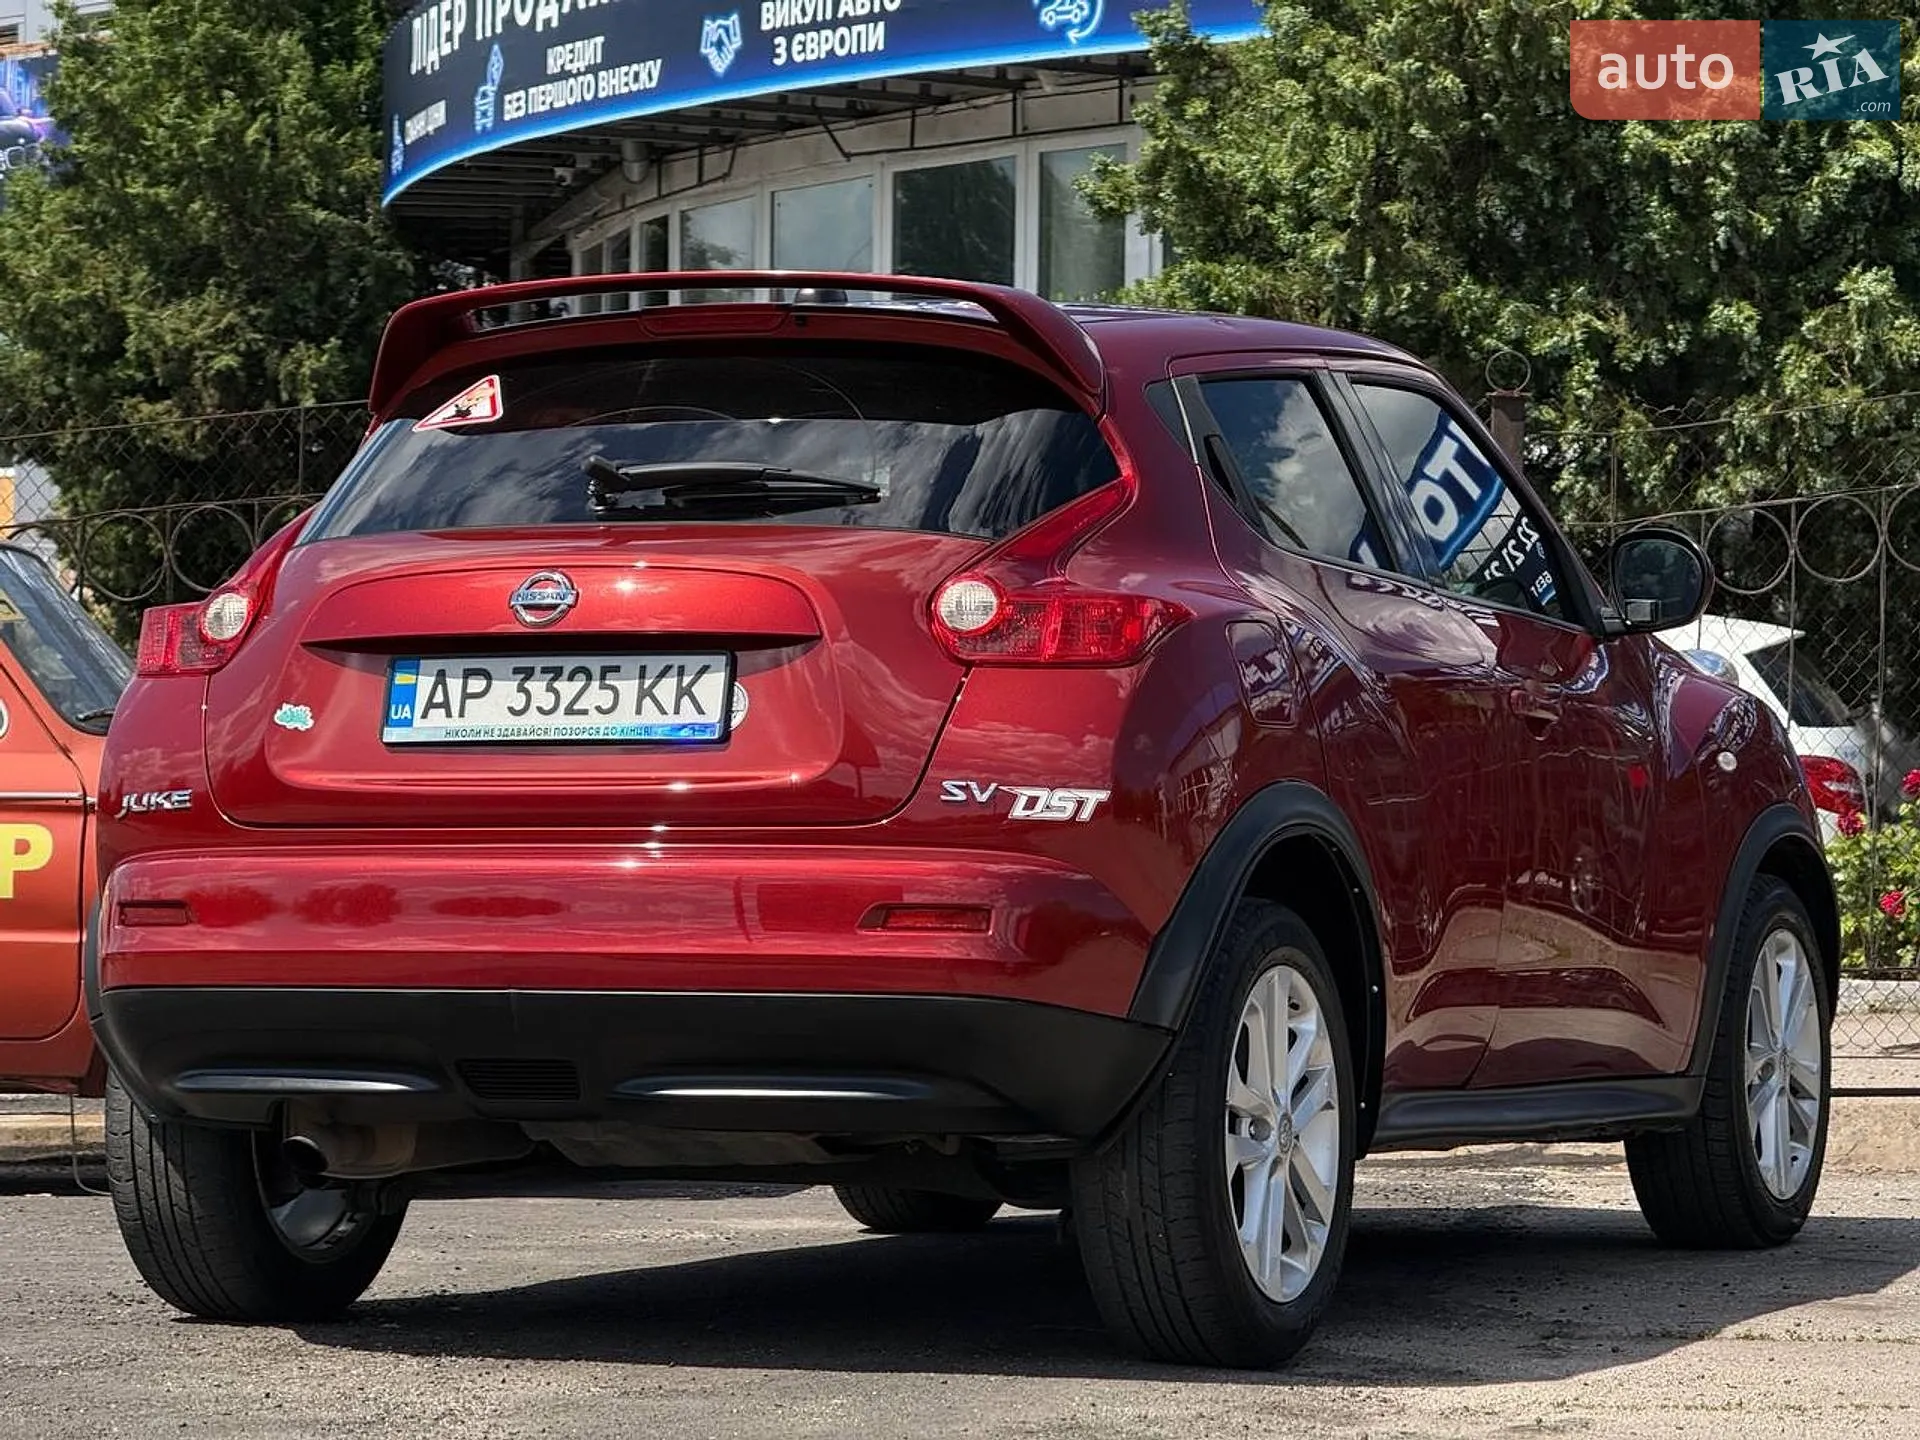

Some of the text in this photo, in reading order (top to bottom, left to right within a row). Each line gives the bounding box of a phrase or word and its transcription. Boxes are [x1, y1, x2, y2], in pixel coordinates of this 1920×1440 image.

[760, 0, 833, 31] ВИКУП
[410, 0, 612, 75] ЛІДЕР ПРОД
[772, 21, 885, 66] З ЄВРОПИ
[546, 36, 605, 75] КРЕДИТ
[503, 59, 662, 121] БЕЗ ПЕРШОГО ВНЕСКУ
[515, 591, 565, 601] NISSAN
[420, 664, 711, 719] AP 3325 KK
[391, 704, 411, 719] UA
[113, 789, 192, 819] JUKE
[940, 780, 998, 802] SV
